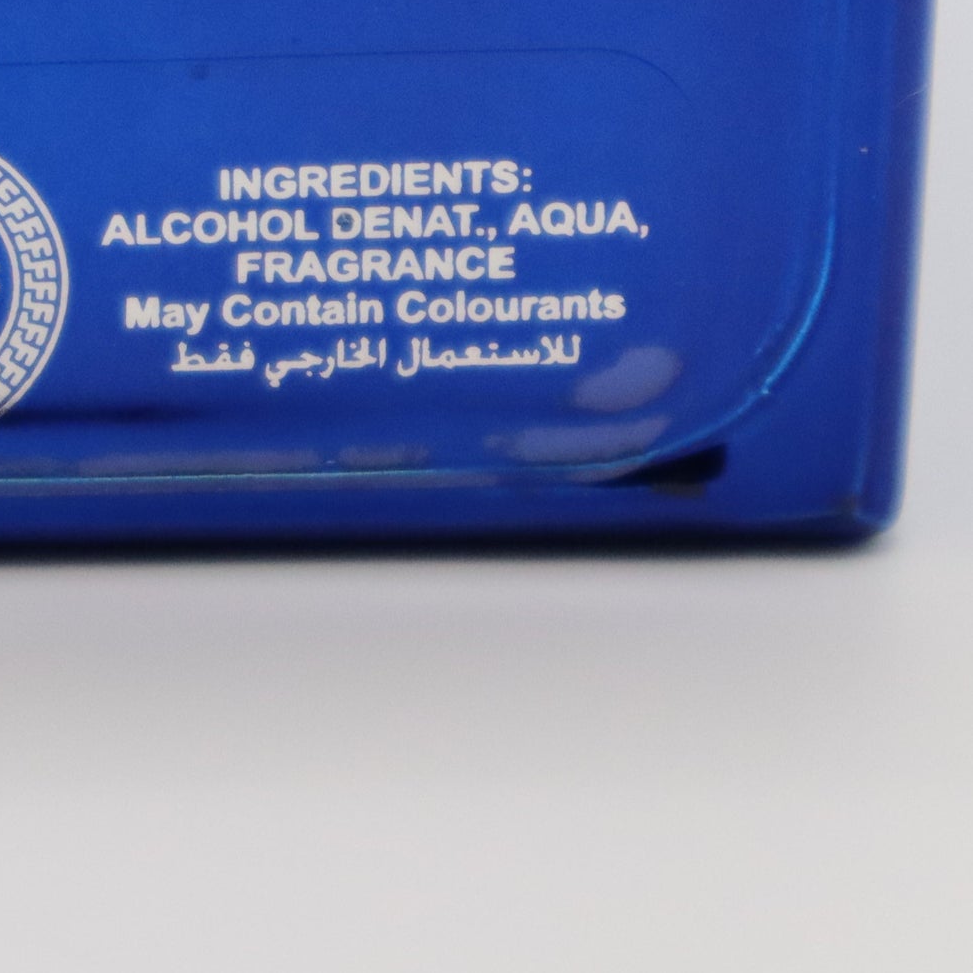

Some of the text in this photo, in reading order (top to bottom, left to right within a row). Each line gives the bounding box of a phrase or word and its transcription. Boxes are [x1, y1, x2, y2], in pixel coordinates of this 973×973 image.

[220, 161, 532, 200] INGREDIENTS:
[102, 202, 649, 246] ALCOHOL DENAT., AQUA,
[238, 247, 515, 283] FRAGRANCE
[126, 289, 626, 335] May Contain Colourants
[172, 335, 581, 388] للاستعمال الخارجي فقط
